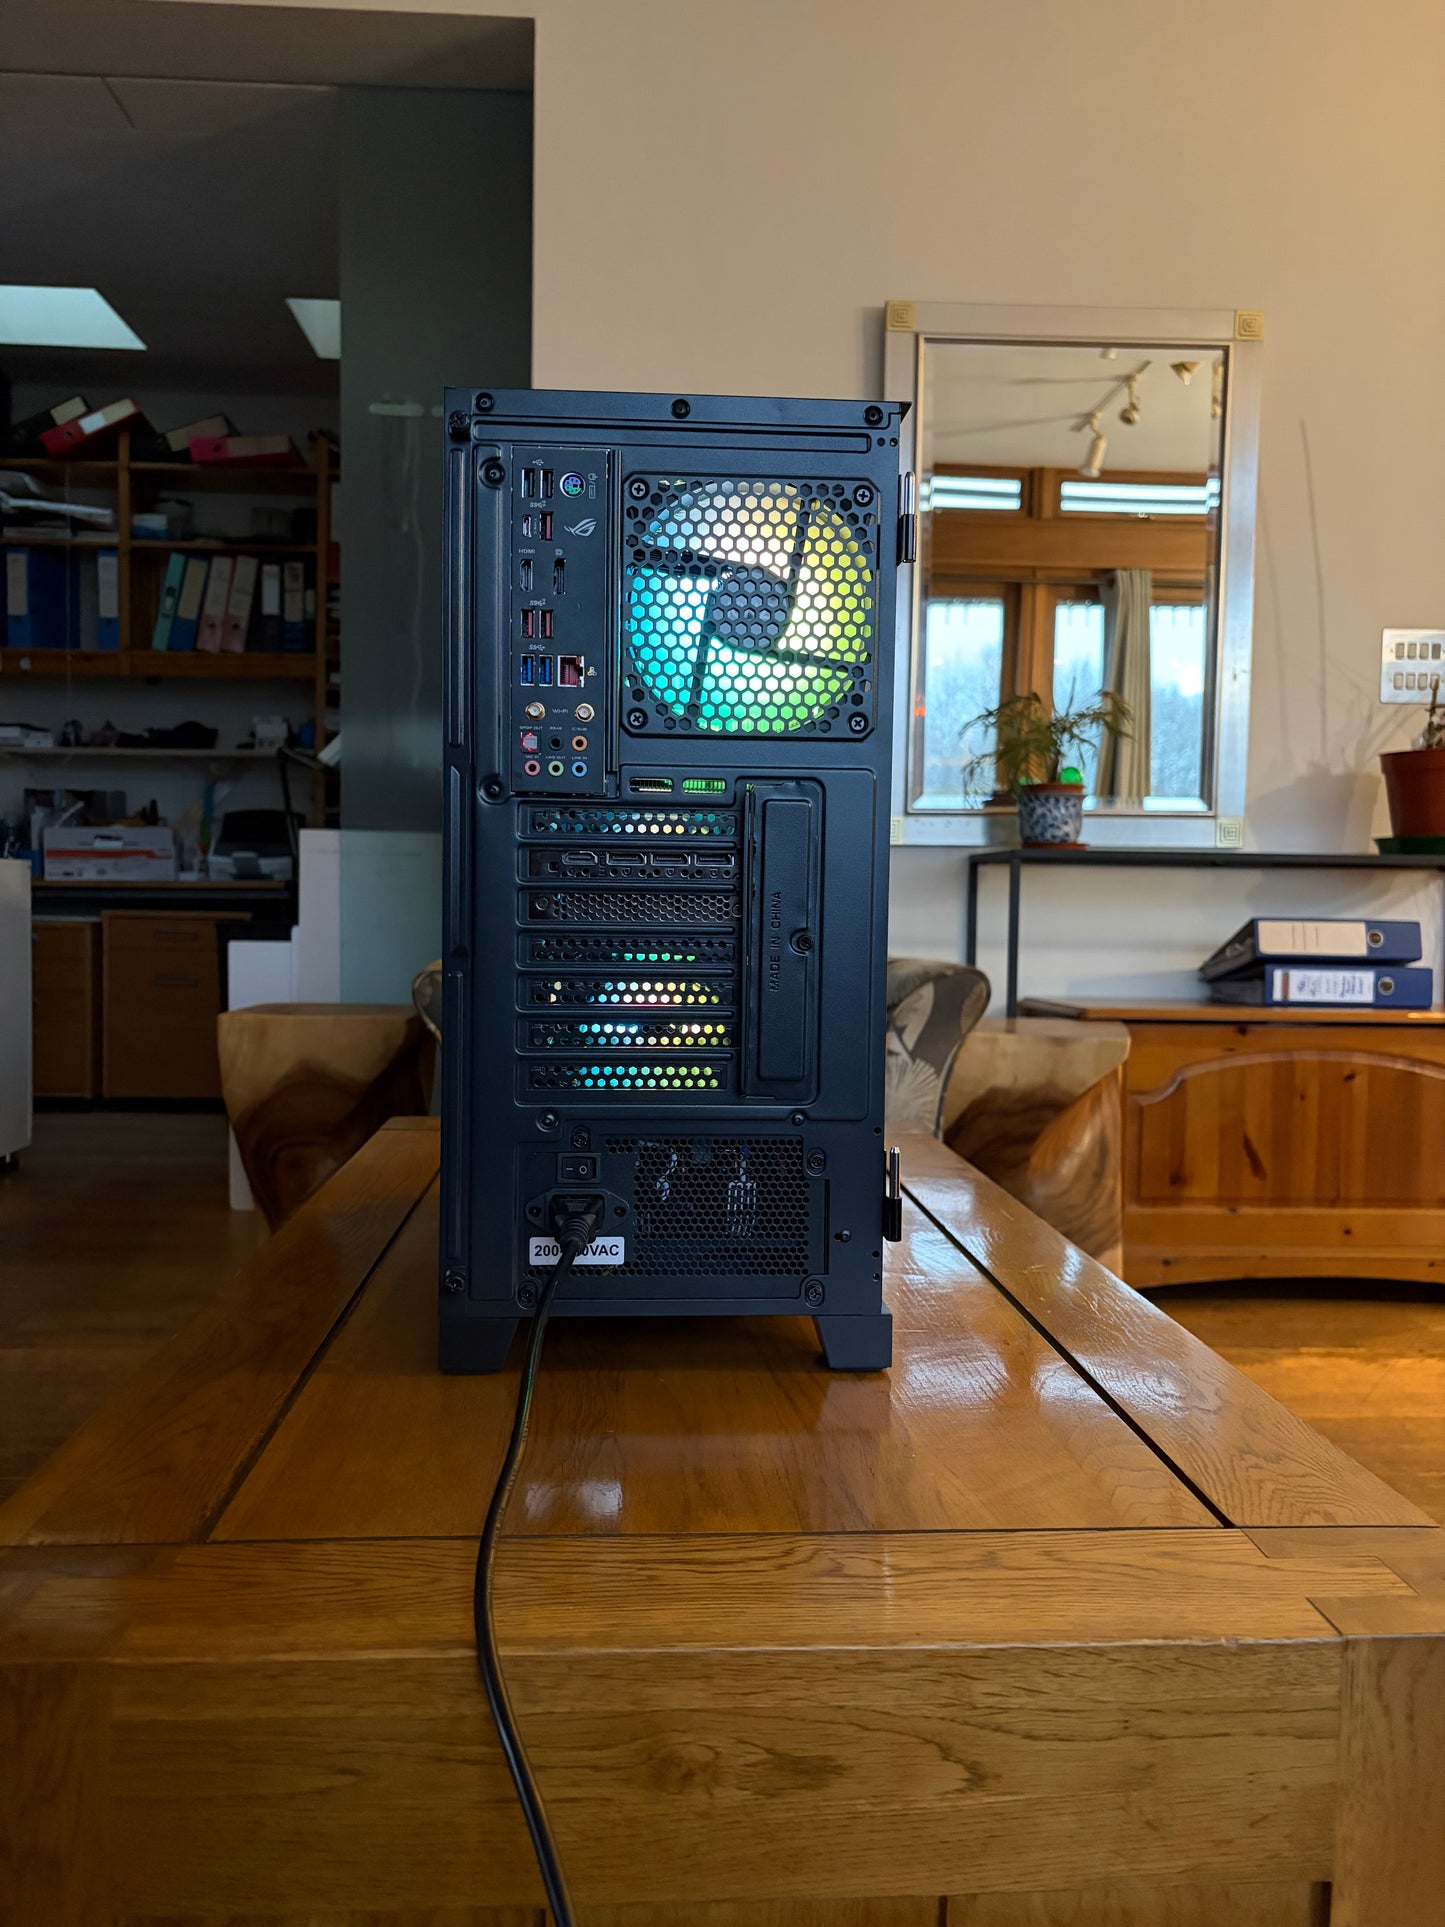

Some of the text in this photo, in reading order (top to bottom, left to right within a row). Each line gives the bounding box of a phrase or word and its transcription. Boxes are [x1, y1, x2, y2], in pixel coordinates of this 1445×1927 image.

[769, 891, 782, 992] MADE IN CHINA
